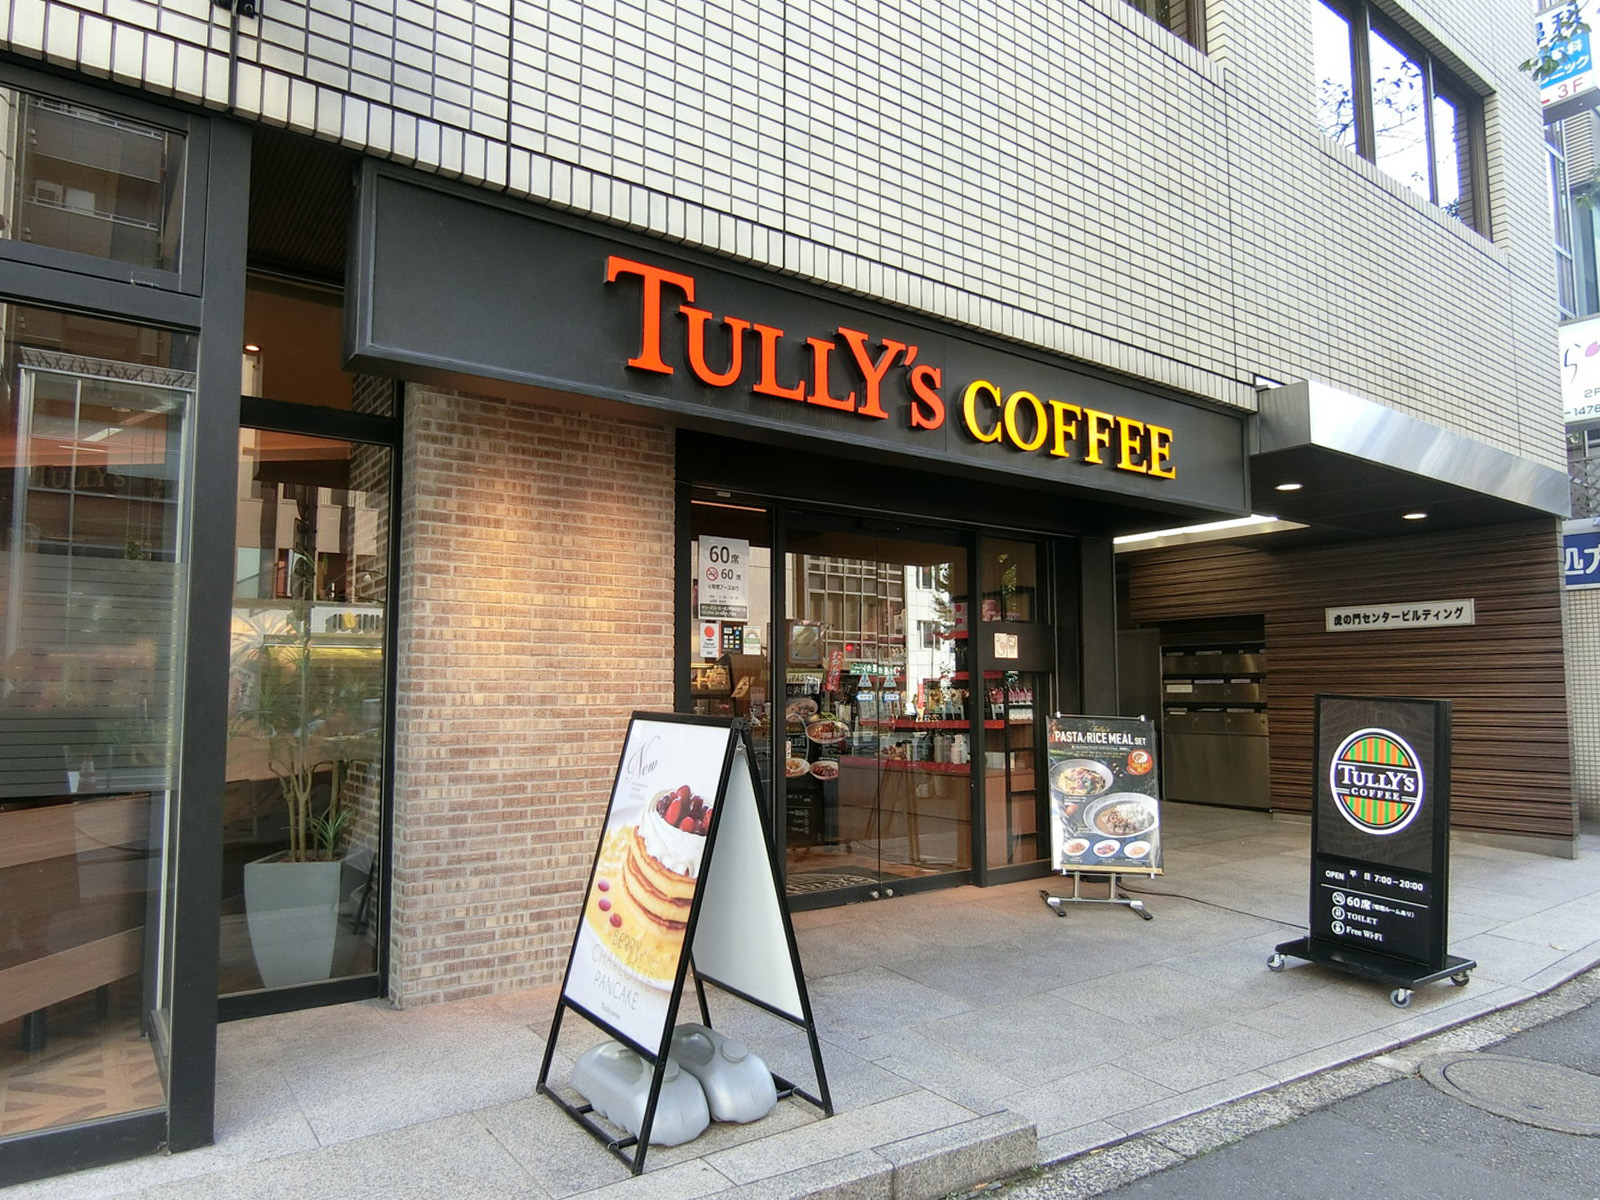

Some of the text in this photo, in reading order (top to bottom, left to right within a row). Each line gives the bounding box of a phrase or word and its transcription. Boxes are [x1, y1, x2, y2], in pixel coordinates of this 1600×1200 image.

[1558, 77, 1583, 98] 3F
[604, 255, 1177, 480] TULLY'S COFFEE
[1333, 606, 1464, 627] 虎の門センタービルディング
[1108, 732, 1134, 745] MEAL
[1134, 737, 1147, 746] SET
[1337, 764, 1415, 792] TULLY'S
[1351, 787, 1400, 801] COFFEE
[1325, 870, 1345, 880] OPEN
[1346, 912, 1378, 925] TOILET
[1346, 926, 1362, 936] Free
[611, 929, 643, 955] BERRY
[593, 970, 639, 1011] PANCAKE
